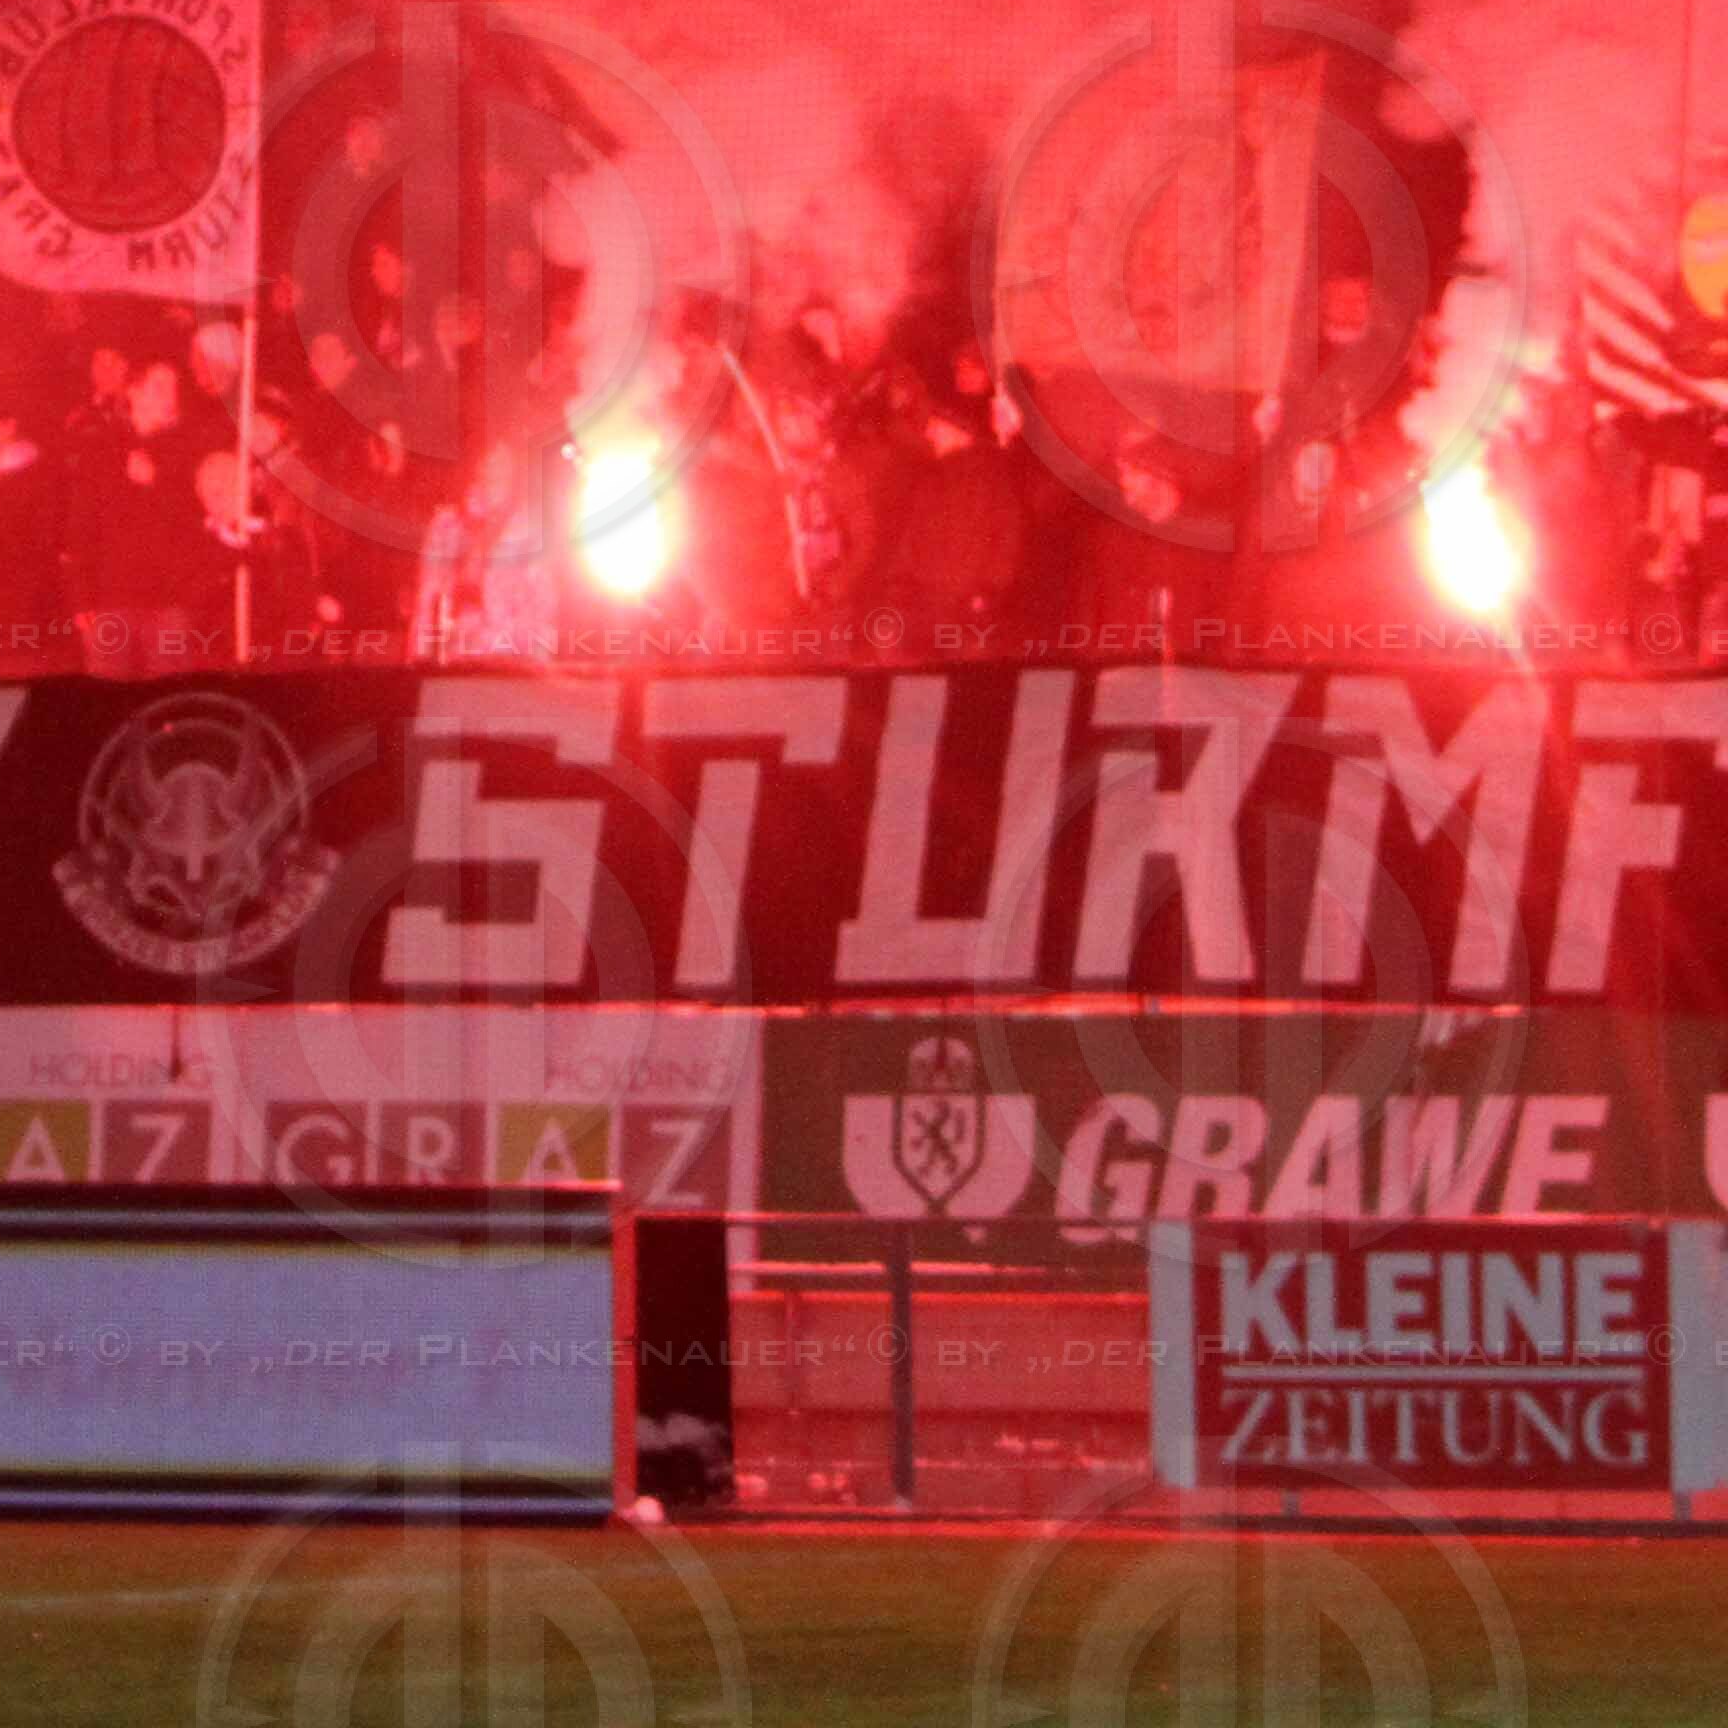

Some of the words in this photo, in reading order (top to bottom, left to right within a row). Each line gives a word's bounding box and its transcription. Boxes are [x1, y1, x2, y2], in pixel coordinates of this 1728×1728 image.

[274, 1113, 704, 1206] GRAZ
[1054, 1093, 1610, 1243] GRAWE
[1220, 1253, 1646, 1357] KLEINE
[1220, 1387, 1650, 1468] ZEITUNG
